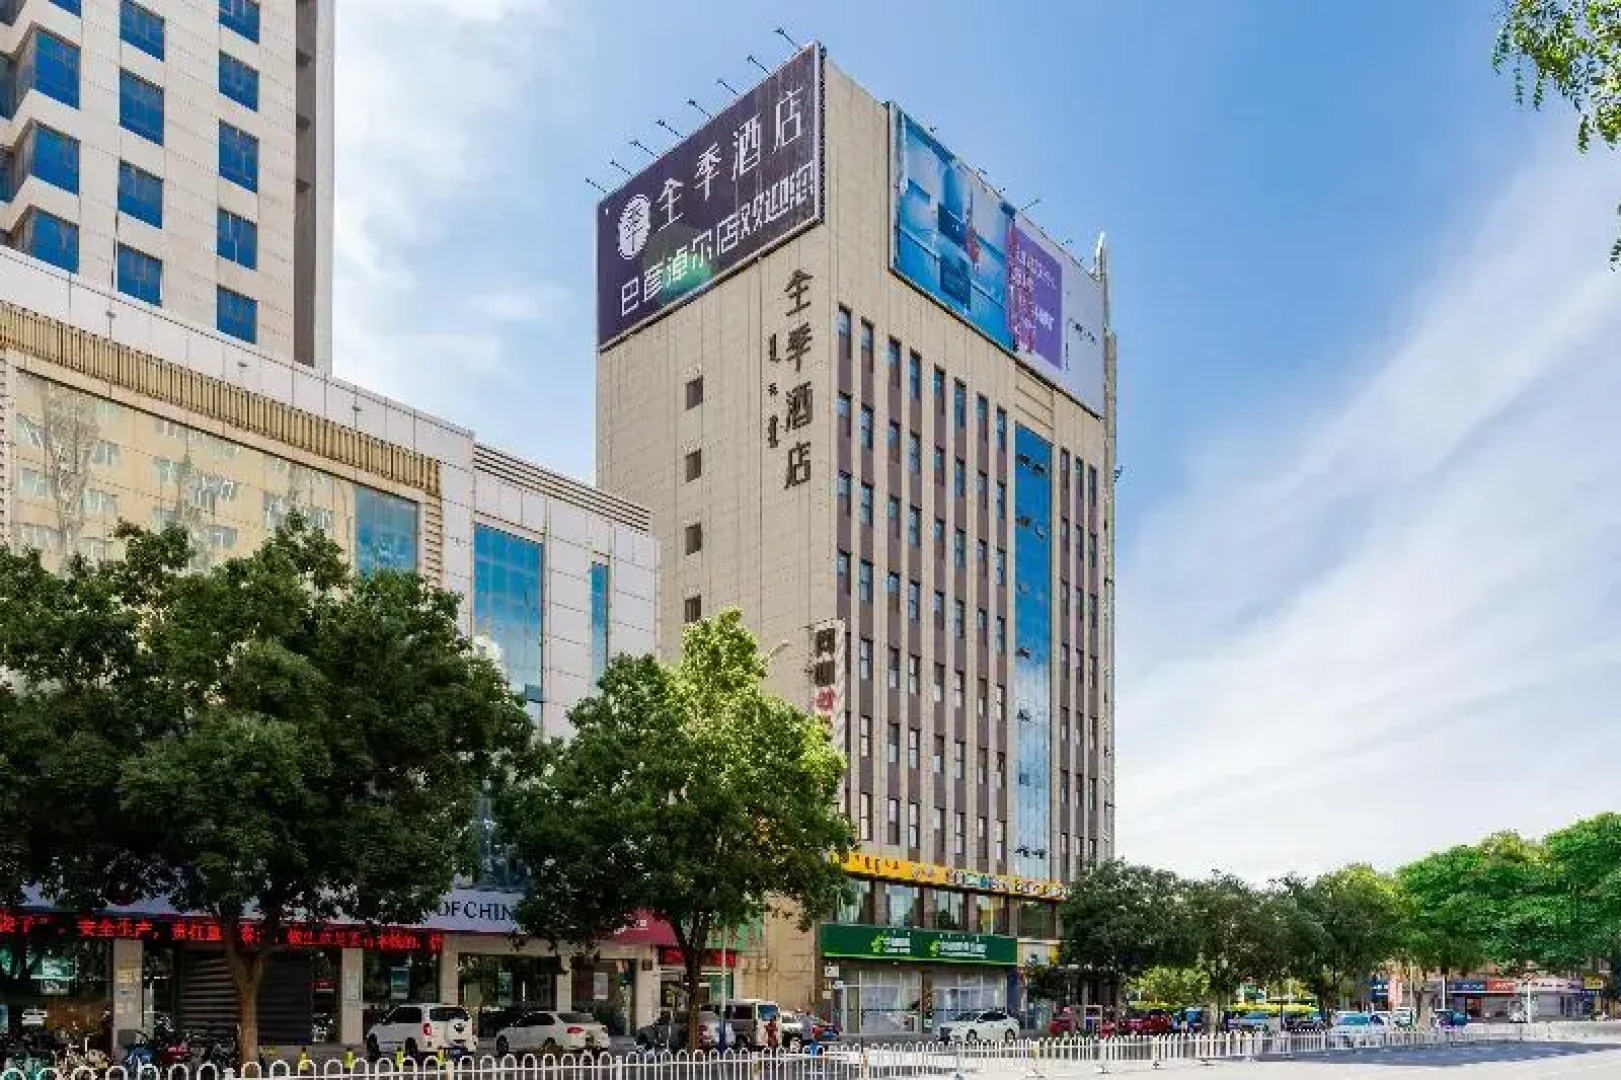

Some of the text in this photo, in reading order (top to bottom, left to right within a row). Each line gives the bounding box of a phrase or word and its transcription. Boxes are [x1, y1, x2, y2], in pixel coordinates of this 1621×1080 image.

[657, 86, 804, 231] 全季酒店
[784, 269, 813, 490] 全季酒店
[464, 901, 516, 921] CHIN
